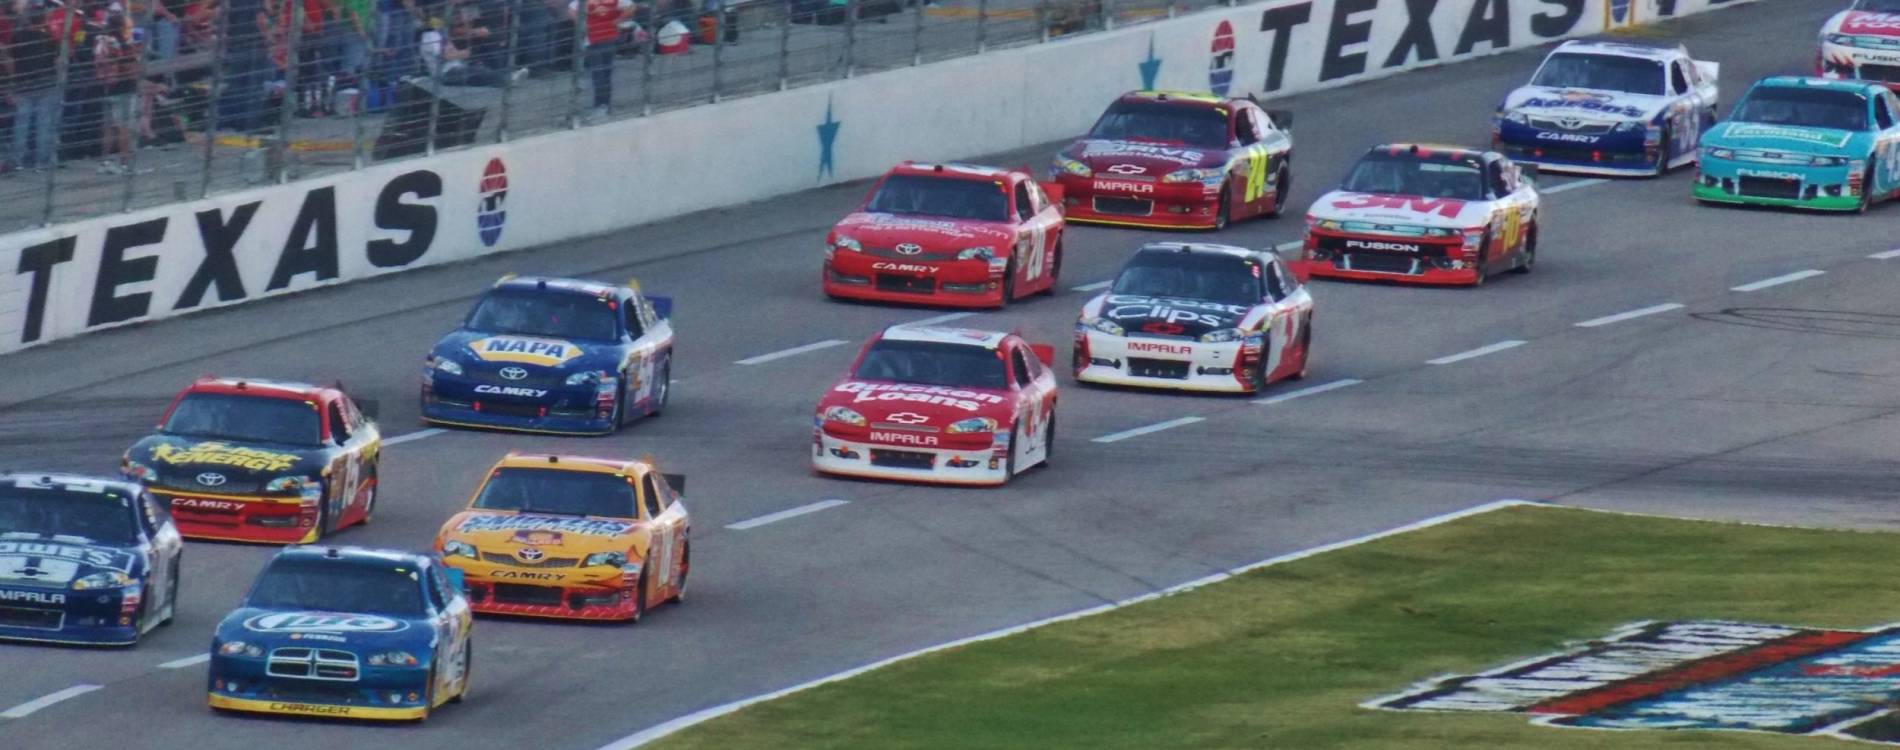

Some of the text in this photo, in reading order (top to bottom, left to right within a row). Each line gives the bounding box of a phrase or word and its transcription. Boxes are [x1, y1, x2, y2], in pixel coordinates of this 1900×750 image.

[1259, 0, 1586, 92] TEXAS
[1536, 131, 1600, 143] CAMRY
[1736, 168, 1806, 180] FUSION
[1093, 180, 1154, 193] IMPALA
[1331, 191, 1467, 219] 3M
[1346, 240, 1419, 252] FUSION
[17, 169, 443, 343] TEXAS
[871, 261, 940, 274] CAMRY
[1108, 304, 1222, 327] Clips
[487, 338, 565, 358] NAPA
[1127, 341, 1193, 355] IMPALA
[474, 384, 548, 398] CAMRY
[834, 382, 1003, 404] Quicken
[853, 390, 981, 411] Loans
[870, 431, 938, 446] IMPALA
[166, 452, 292, 471] ENERGY
[171, 498, 246, 511] CAMRY
[490, 570, 566, 582] CAMRY
[269, 702, 352, 716] CHARGER
